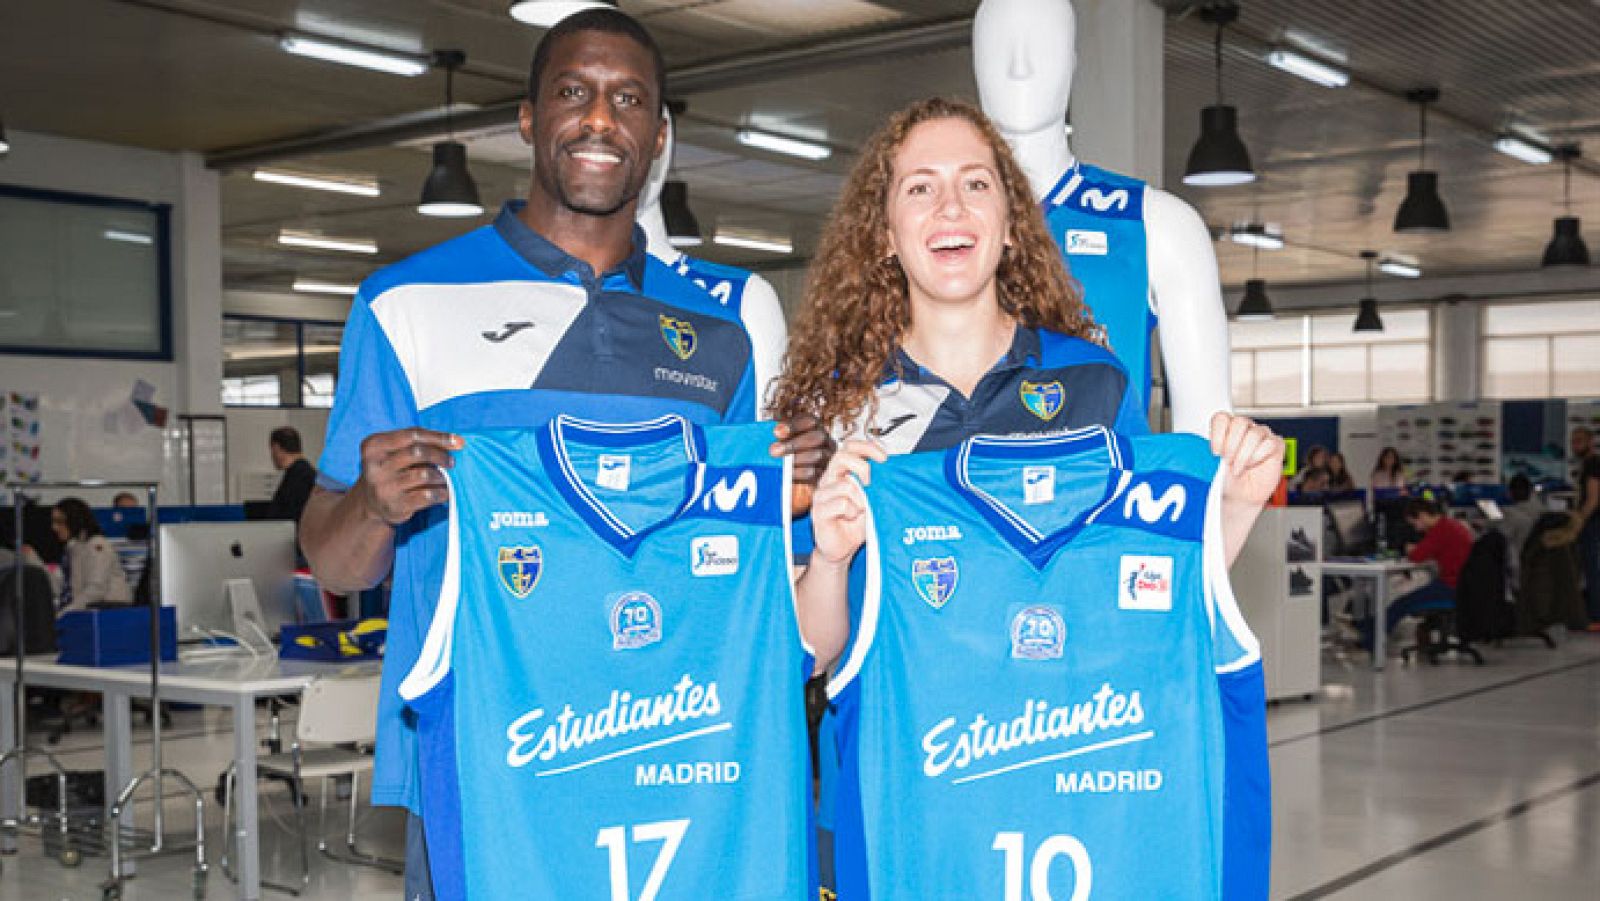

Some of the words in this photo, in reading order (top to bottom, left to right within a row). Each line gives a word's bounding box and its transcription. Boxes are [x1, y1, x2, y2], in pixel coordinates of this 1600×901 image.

[506, 673, 721, 768] Estudiantes
[921, 682, 1145, 778] Estudiantes
[635, 761, 741, 786] MADRID
[1055, 769, 1163, 793] MADRID
[596, 819, 692, 901] 17
[991, 831, 1093, 901] 10
